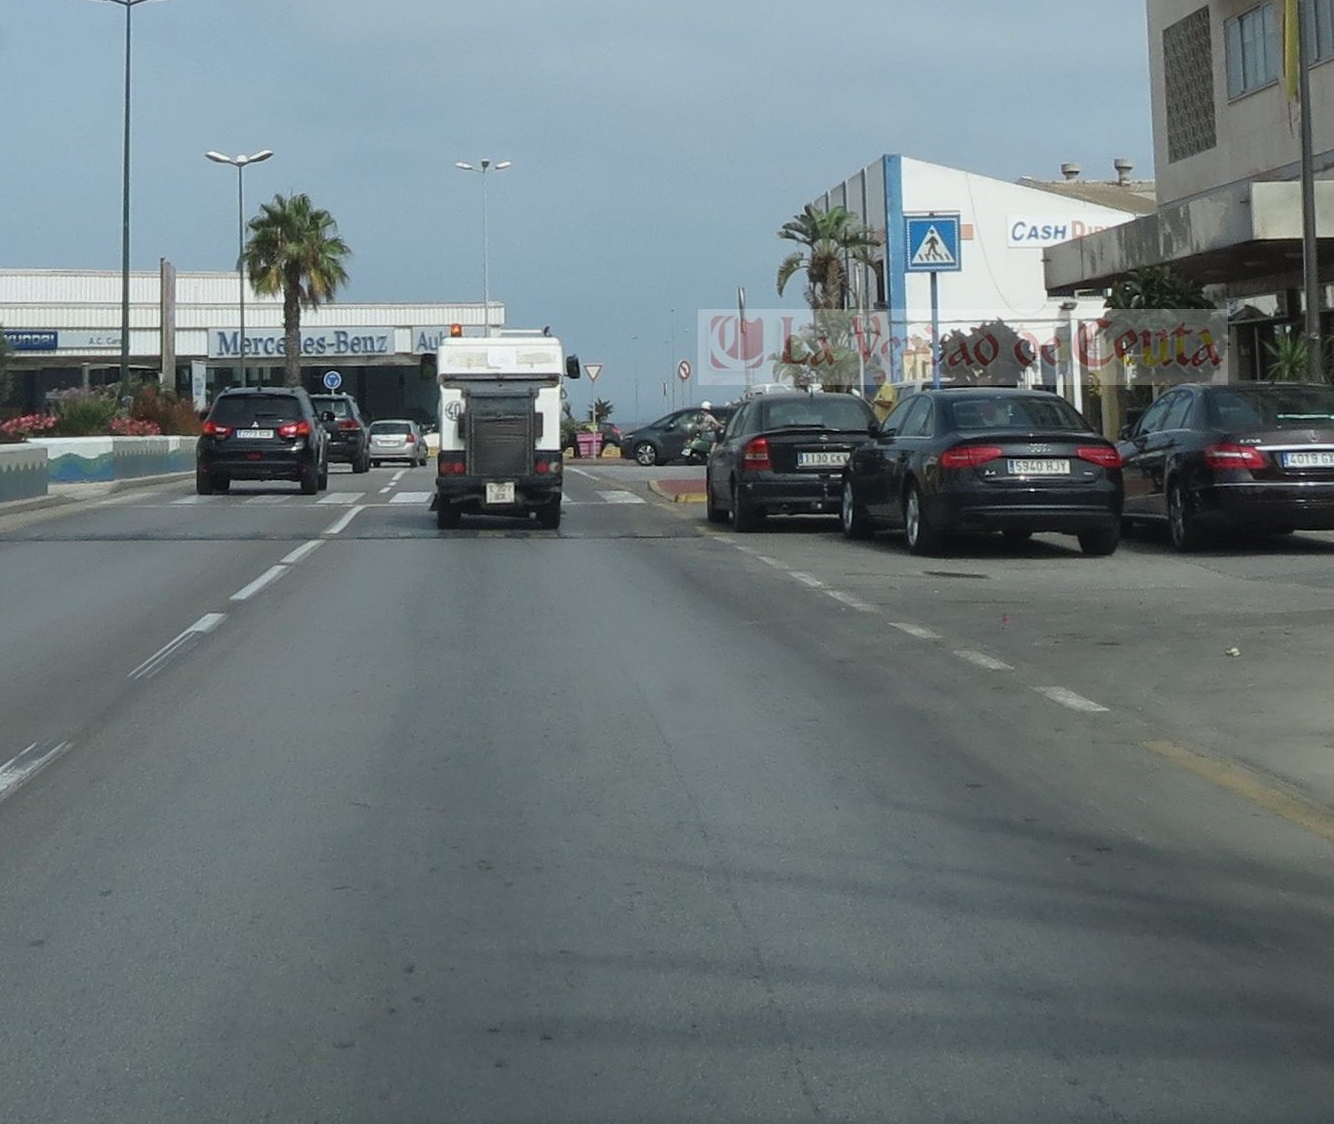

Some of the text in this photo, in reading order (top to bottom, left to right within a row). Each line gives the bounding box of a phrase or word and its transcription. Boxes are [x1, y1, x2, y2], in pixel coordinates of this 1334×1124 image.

[1011, 221, 1067, 241] CASH
[4, 334, 55, 345] YUNDAI
[217, 330, 389, 356] Mercees-Benz
